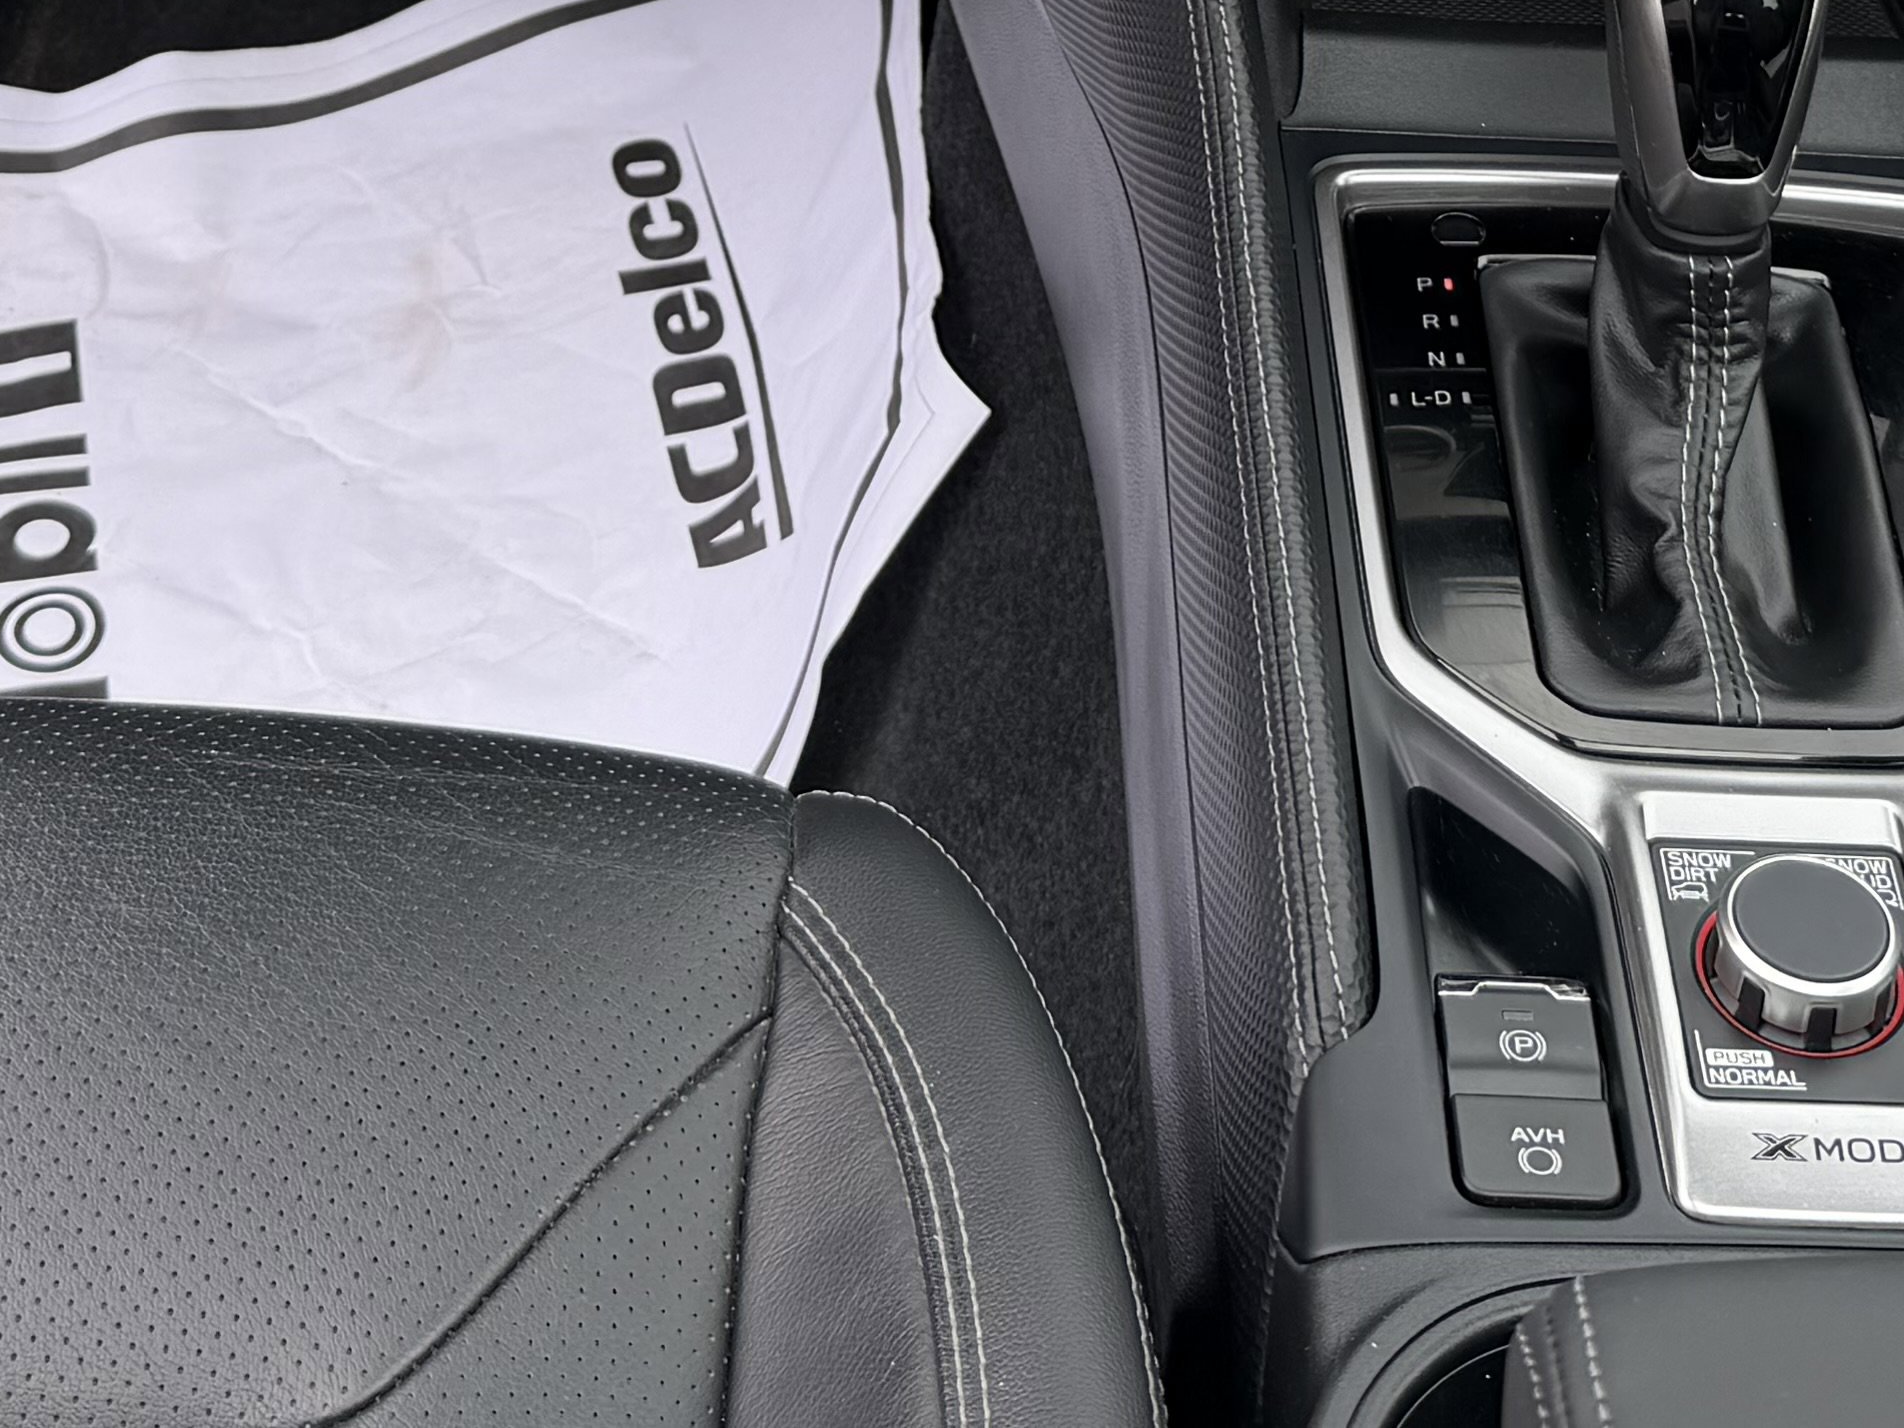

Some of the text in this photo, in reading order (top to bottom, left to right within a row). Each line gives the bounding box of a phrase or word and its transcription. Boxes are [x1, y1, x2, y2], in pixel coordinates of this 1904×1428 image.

[1416, 277, 1433, 292] P
[1422, 314, 1440, 329] R
[611, 138, 769, 568] ACDelco
[1428, 351, 1446, 366] N
[1667, 852, 1732, 869] SNOW
[1670, 867, 1719, 883] DIRT
[1713, 1051, 1767, 1065] PUSH
[1709, 1068, 1807, 1086] NORMAL
[1511, 1126, 1566, 1144] AVH
